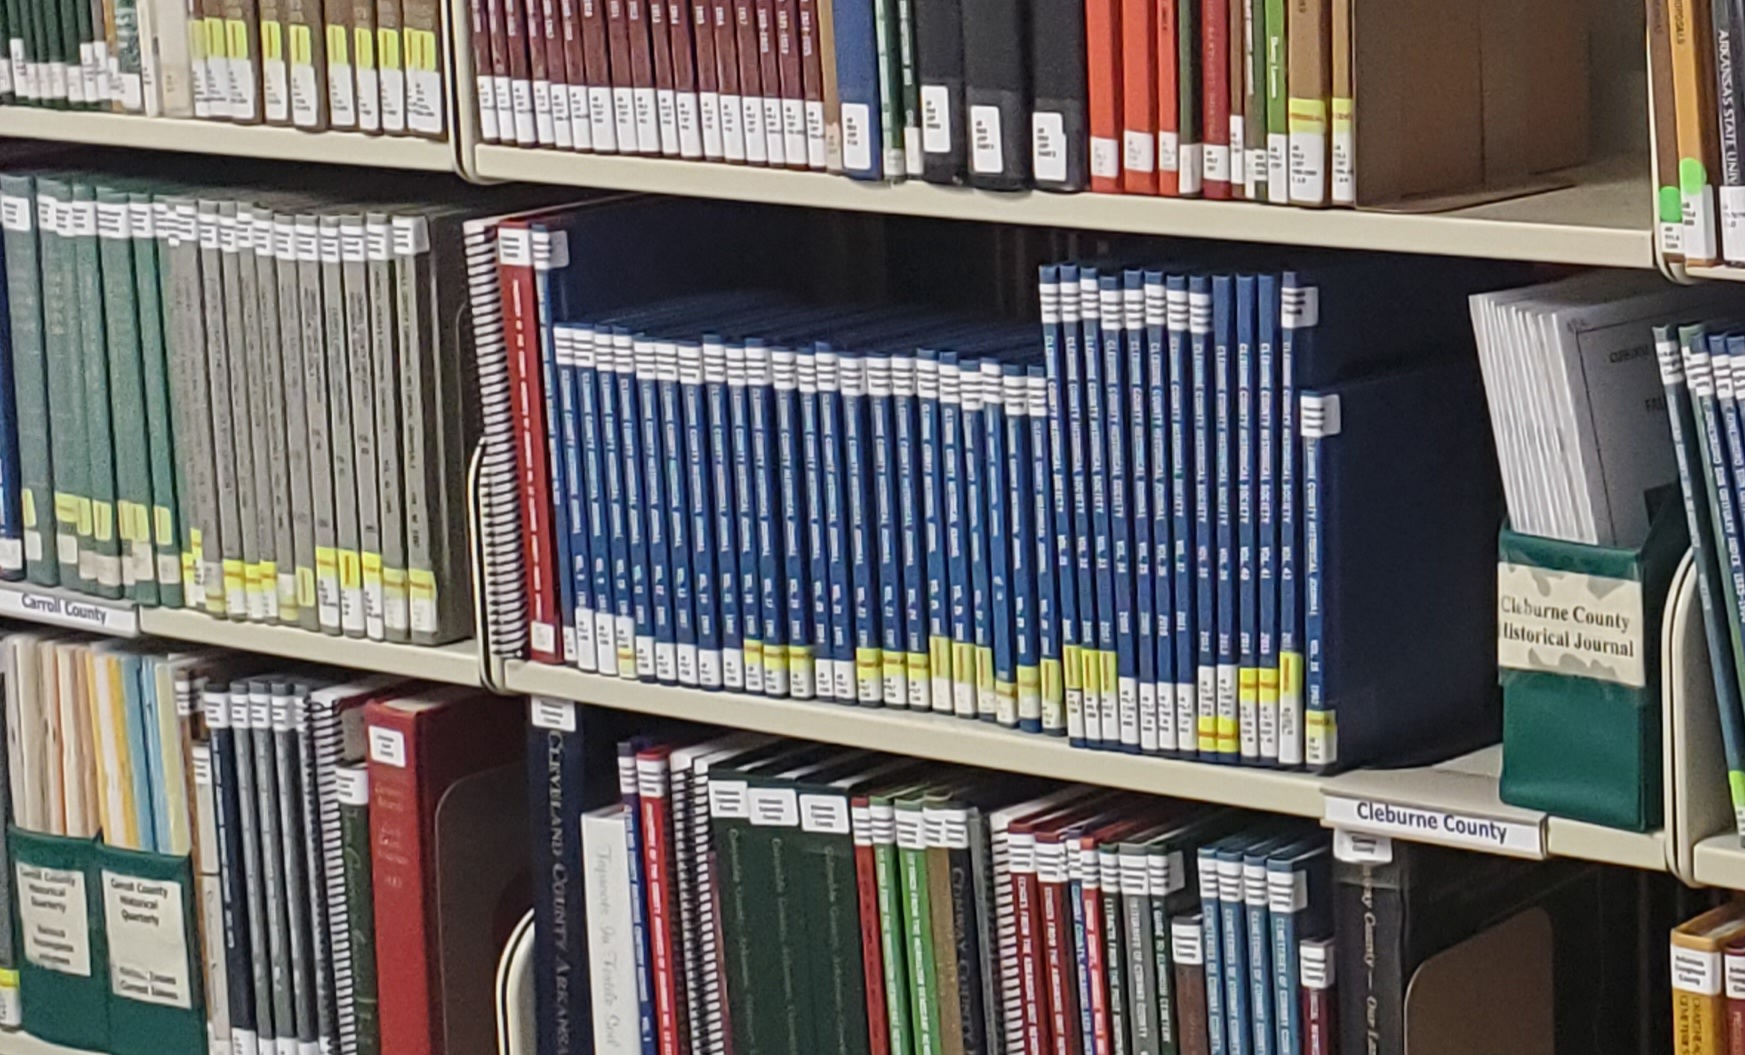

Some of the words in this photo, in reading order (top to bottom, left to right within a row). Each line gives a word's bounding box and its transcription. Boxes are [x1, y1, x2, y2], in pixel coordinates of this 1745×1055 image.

[1717, 28, 1736, 106] ARKANSAS
[1722, 107, 1737, 146] STATE
[1724, 150, 1741, 184] UNIV
[21, 592, 61, 613] Carroll
[64, 600, 107, 626] County
[1572, 605, 1629, 633] County
[1574, 632, 1634, 657] Journal
[1356, 802, 1438, 830] Cleburne
[1443, 814, 1507, 844] County
[137, 882, 168, 899] County
